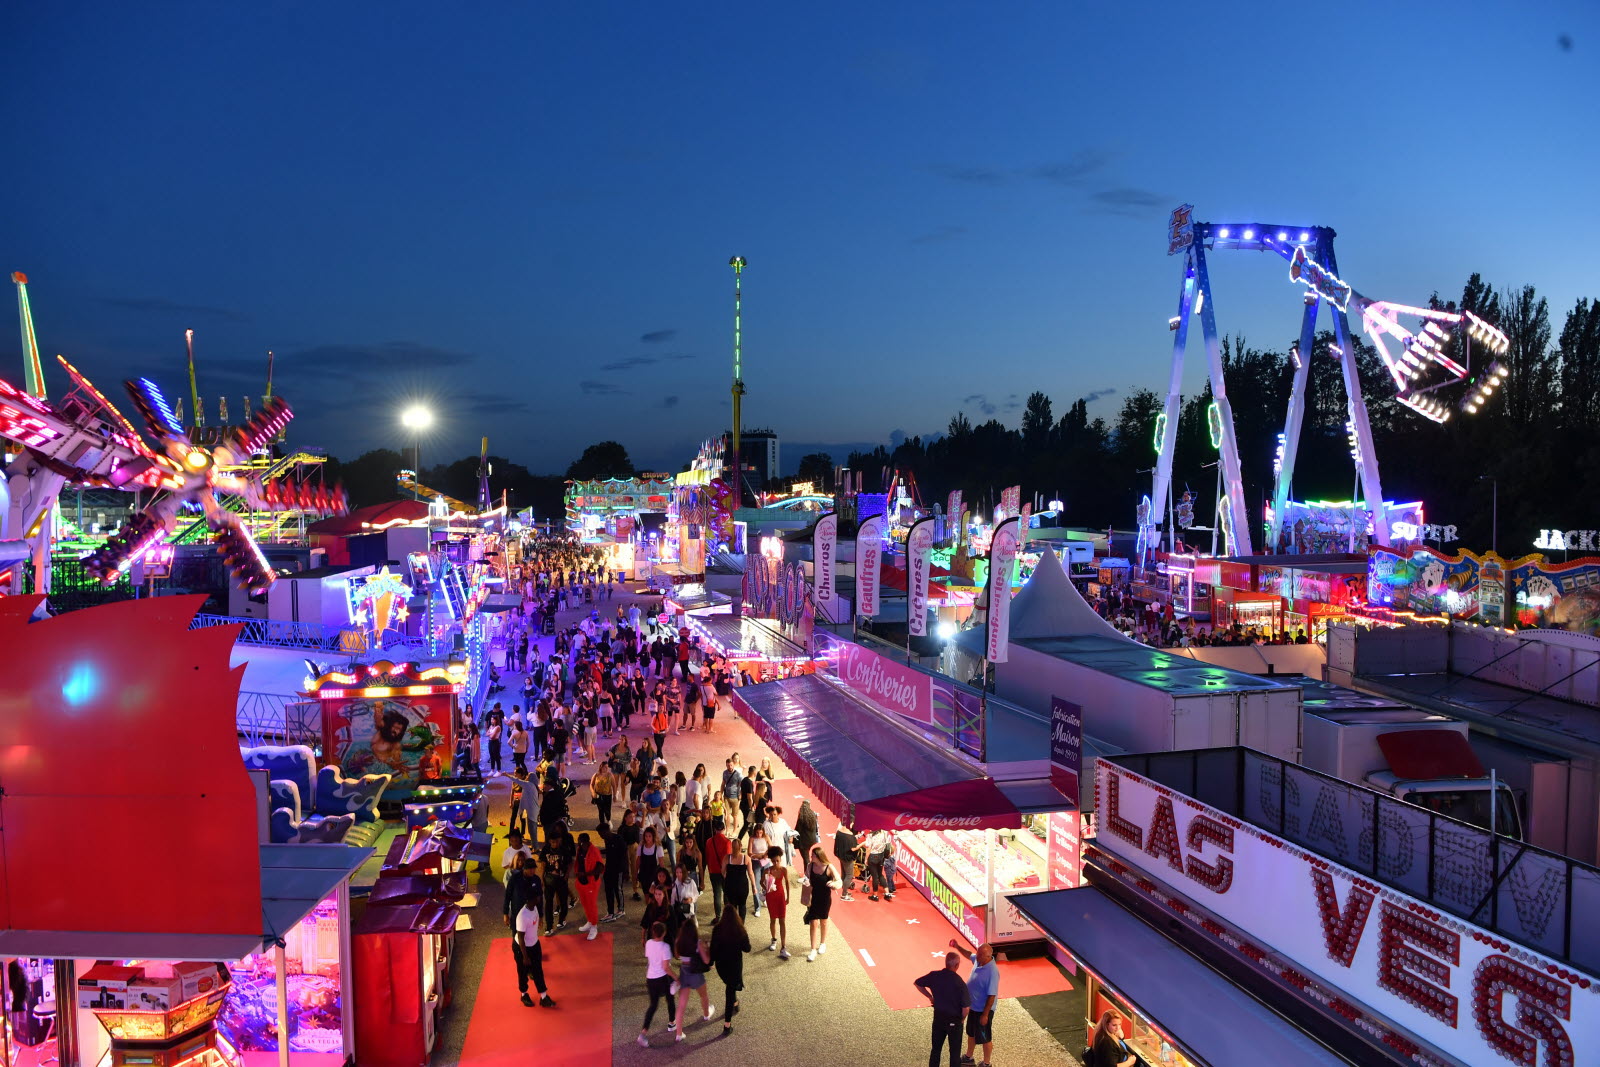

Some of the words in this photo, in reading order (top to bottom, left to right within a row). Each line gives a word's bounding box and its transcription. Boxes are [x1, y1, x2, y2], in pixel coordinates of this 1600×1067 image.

[1390, 521, 1460, 543] SUPER
[818, 542, 831, 601] Churros
[860, 549, 877, 614] Gaufres
[909, 557, 924, 634] Crêpes
[847, 646, 917, 711] Confiseries
[1052, 722, 1080, 748] Maison
[894, 811, 983, 828] Confiserie
[1106, 772, 1235, 894] LAS
[925, 867, 965, 923] Nougat
